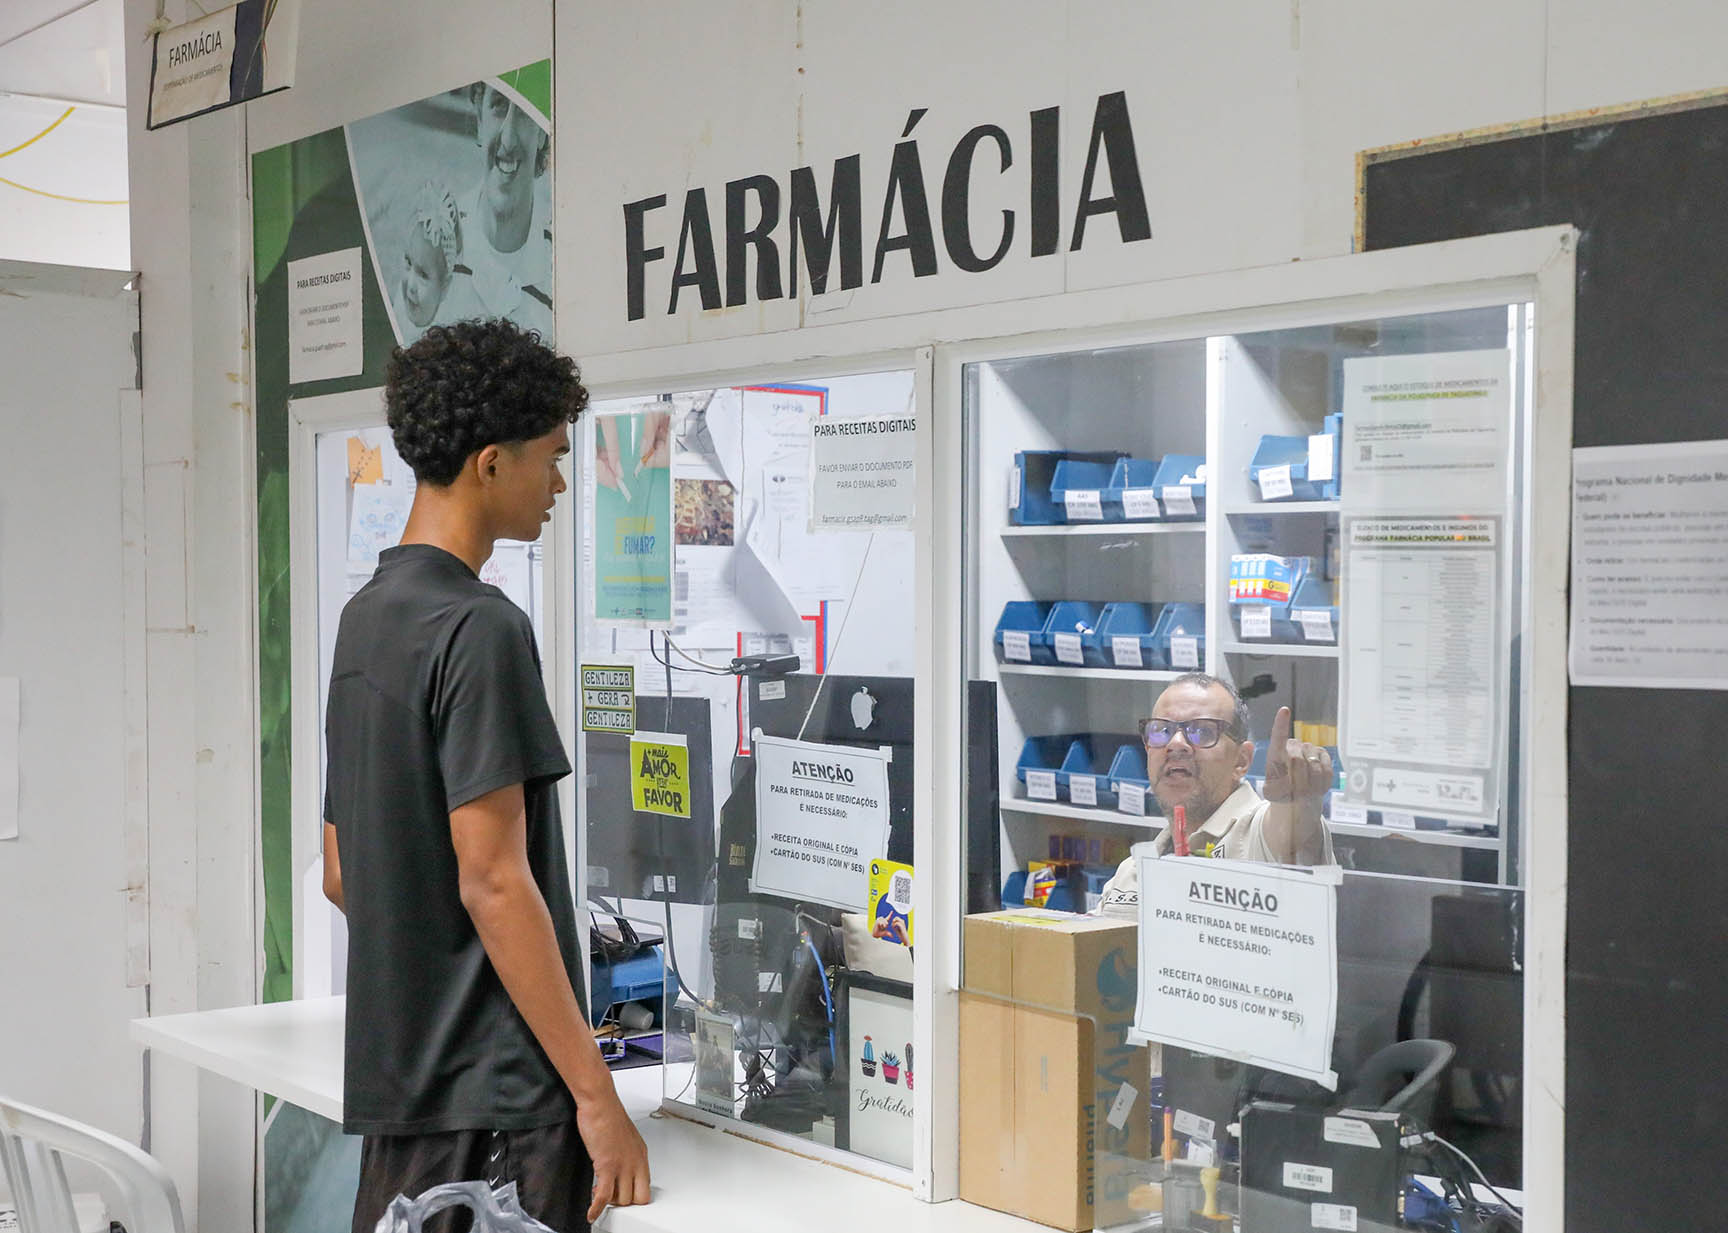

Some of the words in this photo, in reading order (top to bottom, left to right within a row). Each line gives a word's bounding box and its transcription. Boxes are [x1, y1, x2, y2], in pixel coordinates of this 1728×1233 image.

[169, 29, 223, 68] FARMÁCIA
[622, 90, 1152, 322] FARMÁCIA
[297, 280, 309, 288] PARA
[309, 274, 329, 287] RECEITAS
[330, 271, 351, 282] DIGITAIS
[814, 424, 838, 436] PARA
[839, 421, 878, 436] RECEITAS
[879, 418, 917, 433] DIGITAIS
[819, 463, 838, 472] FAVOR
[840, 463, 858, 472] ENVIAR
[859, 463, 864, 472] O
[865, 461, 902, 472] DOCUMENTO
[902, 460, 913, 470] PDF
[837, 480, 852, 488] PARA
[853, 480, 858, 488] O
[858, 480, 876, 488] EMAIL
[876, 478, 896, 488] ABAIXO
[624, 536, 656, 555] FUMAR?
[585, 672, 630, 686] GENTILEZA
[598, 692, 619, 706] GERA
[587, 712, 630, 728] GENTILEZA
[640, 749, 681, 780] AMOR
[792, 761, 854, 784] ATENÇÃO
[643, 788, 683, 814] FAVOR
[770, 784, 788, 794] PARA
[790, 787, 824, 800] RETIRADA
[825, 792, 834, 801] DE
[836, 793, 878, 809] MEDICAÇÕES
[774, 833, 802, 845] RECEITA
[803, 838, 834, 851] ORIGINAL
[773, 848, 800, 860] CARTÃO
[801, 853, 810, 862] DO
[812, 854, 826, 864] SUS
[826, 857, 842, 868] (COM
[851, 862, 864, 875] SES)
[1189, 881, 1278, 913] ATENÇÃO
[1156, 908, 1183, 921] PARA
[1186, 913, 1232, 930] RETIRADA
[1234, 922, 1247, 932] DE
[1250, 925, 1314, 946] MEDICAÇÕES
[1162, 968, 1202, 985] RECEITA
[1206, 976, 1250, 994] ORIGINAL
[1162, 985, 1200, 1002] CARTÃO
[1202, 993, 1216, 1005] DO
[1218, 996, 1238, 1010] SUS
[1240, 1000, 1266, 1016] (COM
[1282, 1010, 1304, 1026] SES)
